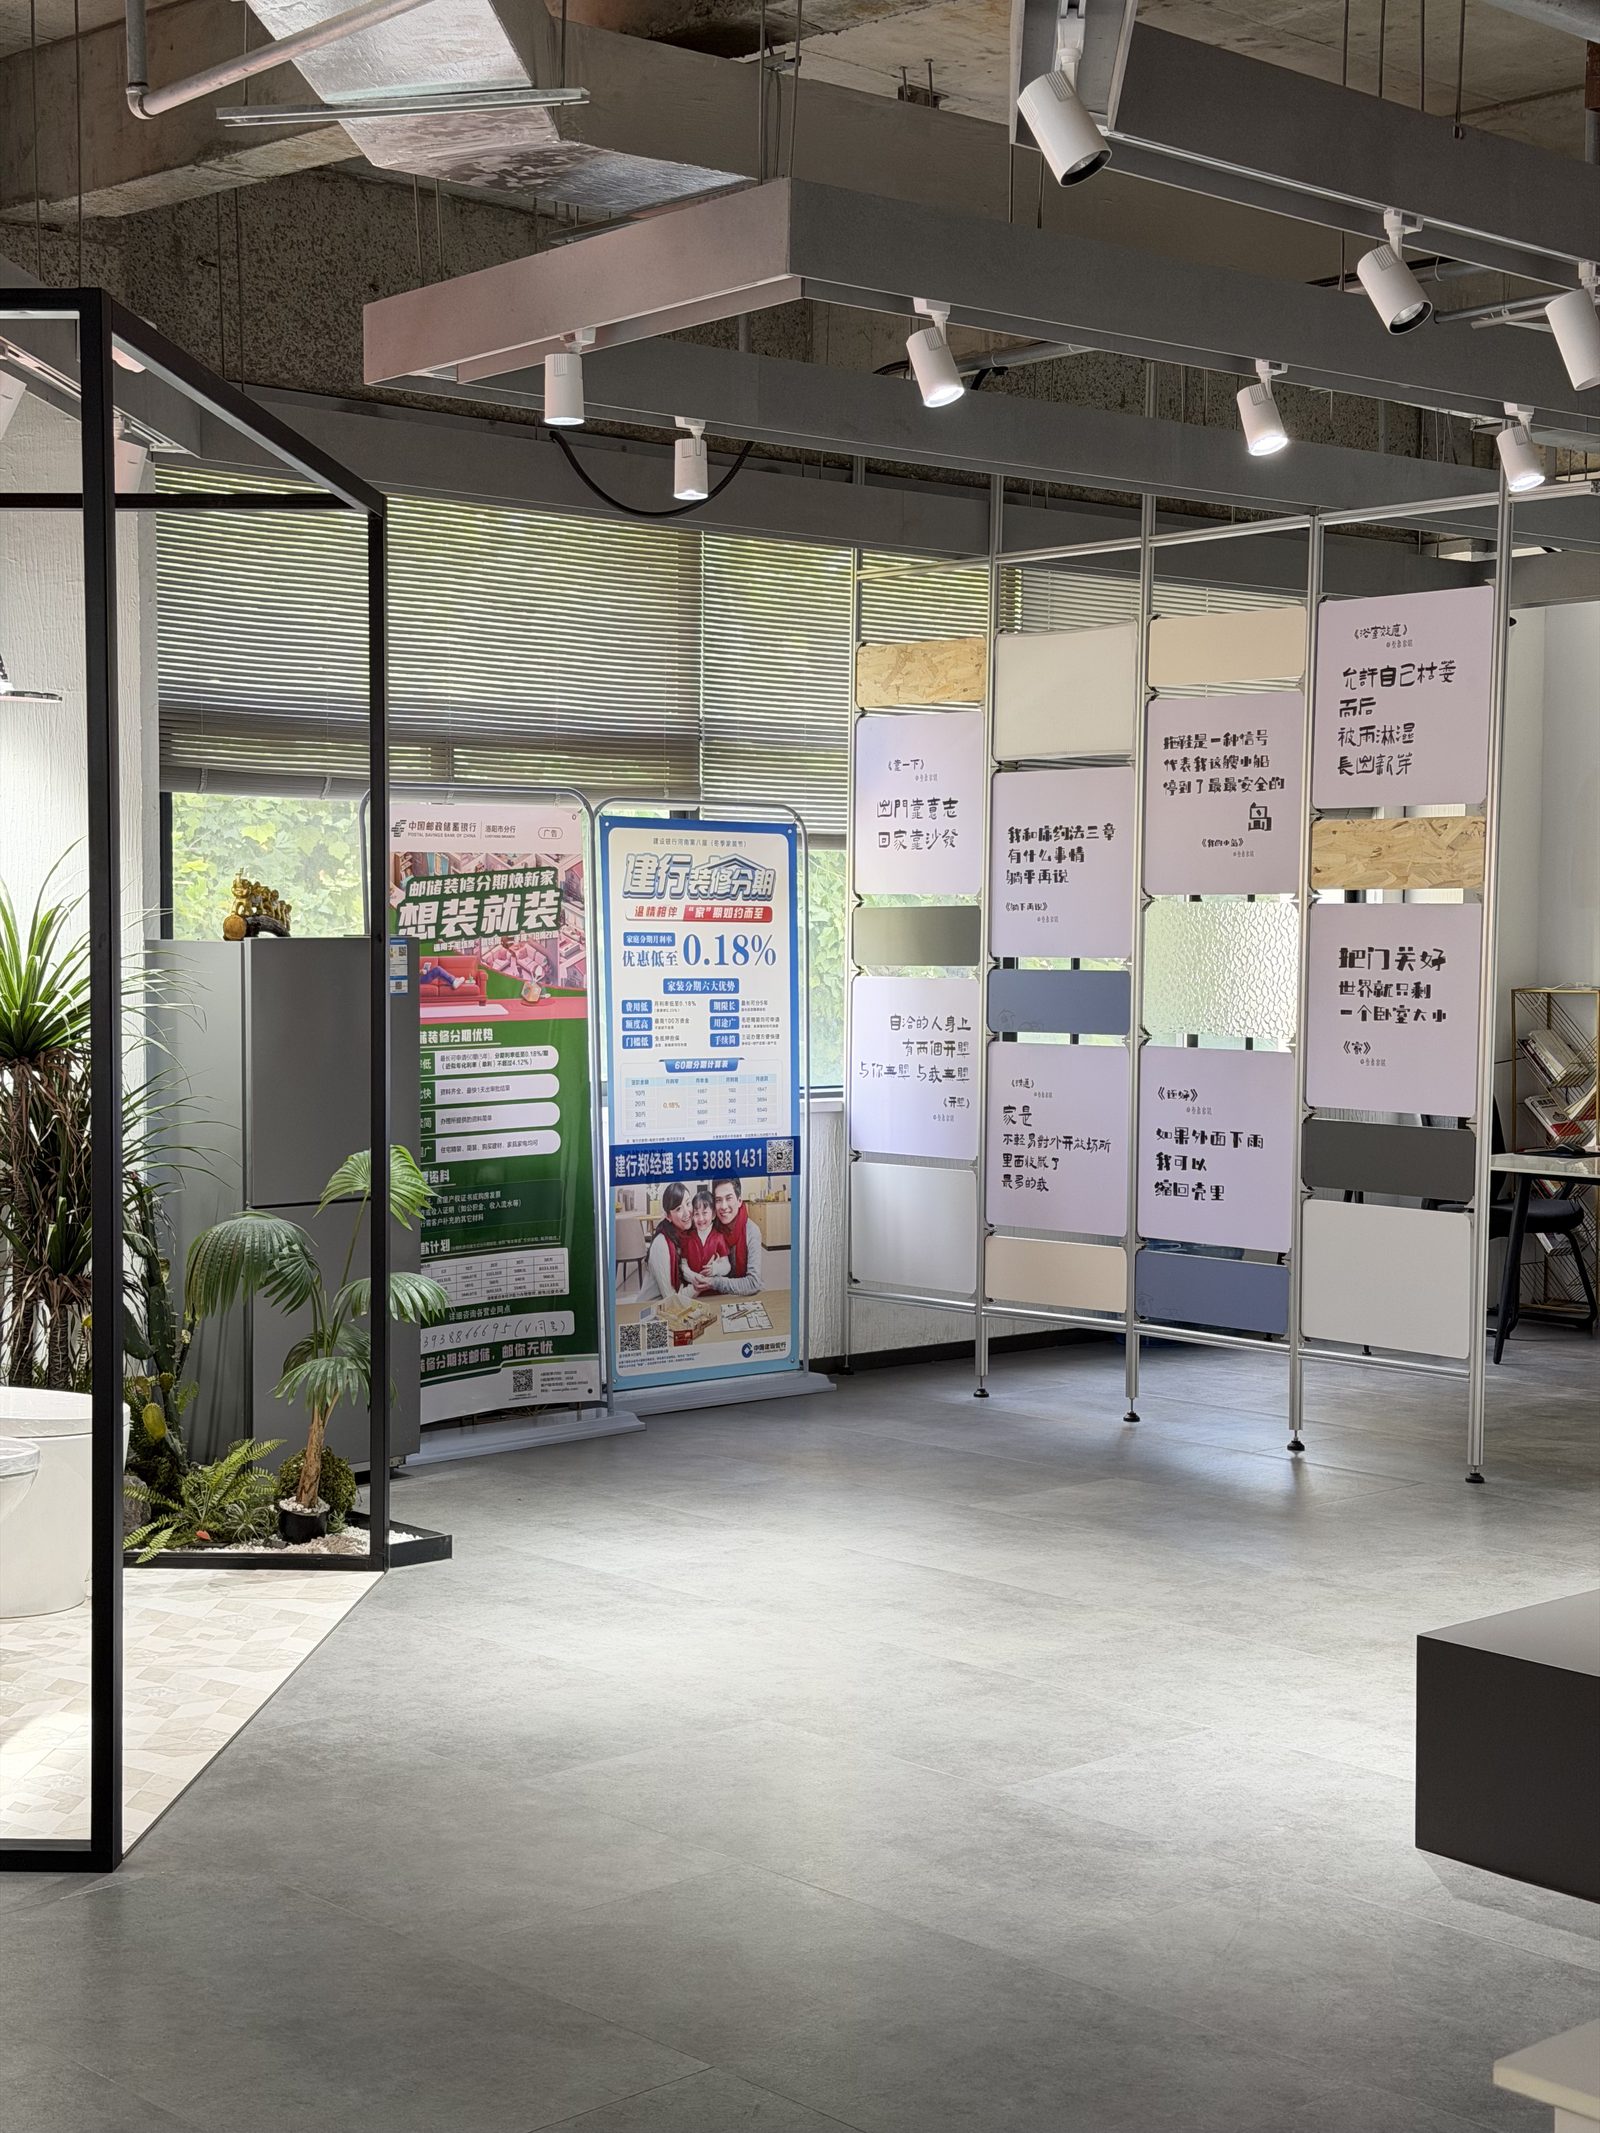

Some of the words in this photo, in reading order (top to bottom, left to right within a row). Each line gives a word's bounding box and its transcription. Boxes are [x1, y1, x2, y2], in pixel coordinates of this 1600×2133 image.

[1342, 660, 1457, 690] 允許自己枯萎
[1163, 729, 1268, 750] 拖鞋是一种信号
[1163, 754, 1270, 772] 代表我这艘小船
[1163, 776, 1285, 796] 停到了最最安全的
[408, 820, 477, 833] 中国邮政储蓄银行
[1248, 802, 1272, 831] 岛
[543, 829, 558, 838] 广告
[1008, 822, 1116, 843] 我和床约法三章
[1008, 846, 1085, 864] 有什么事情
[409, 870, 556, 897] 邮储装修分期焕新家
[623, 853, 776, 900] 建行装修分期
[1006, 869, 1069, 885] 躺平再说
[398, 890, 560, 939] 想装就装
[634, 906, 678, 917] 温情相伴
[623, 950, 678, 967] 优惠低至
[683, 934, 777, 966] 0.18%
[1338, 946, 1447, 972] 把门关好
[667, 981, 736, 992] 家装分期六大优势
[1338, 979, 1431, 999] 世界就只剩
[626, 1002, 649, 1013] 费用低
[713, 1001, 736, 1011] 期限长
[1340, 1004, 1447, 1024] 一个卧室大小
[714, 1018, 736, 1028] 用途广
[890, 1013, 972, 1032] 自洽的人身上
[1342, 1040, 1371, 1055] 《家》
[1002, 1104, 1033, 1127] 家是
[1156, 1126, 1264, 1149] 如果外面下雨
[615, 1152, 674, 1178] 建行郑经理
[677, 1152, 699, 1171] 155
[702, 1150, 731, 1170] 3888
[735, 1148, 762, 1167] 1431
[1155, 1151, 1207, 1172] 我可以
[1154, 1179, 1225, 1201] 缩回壳里
